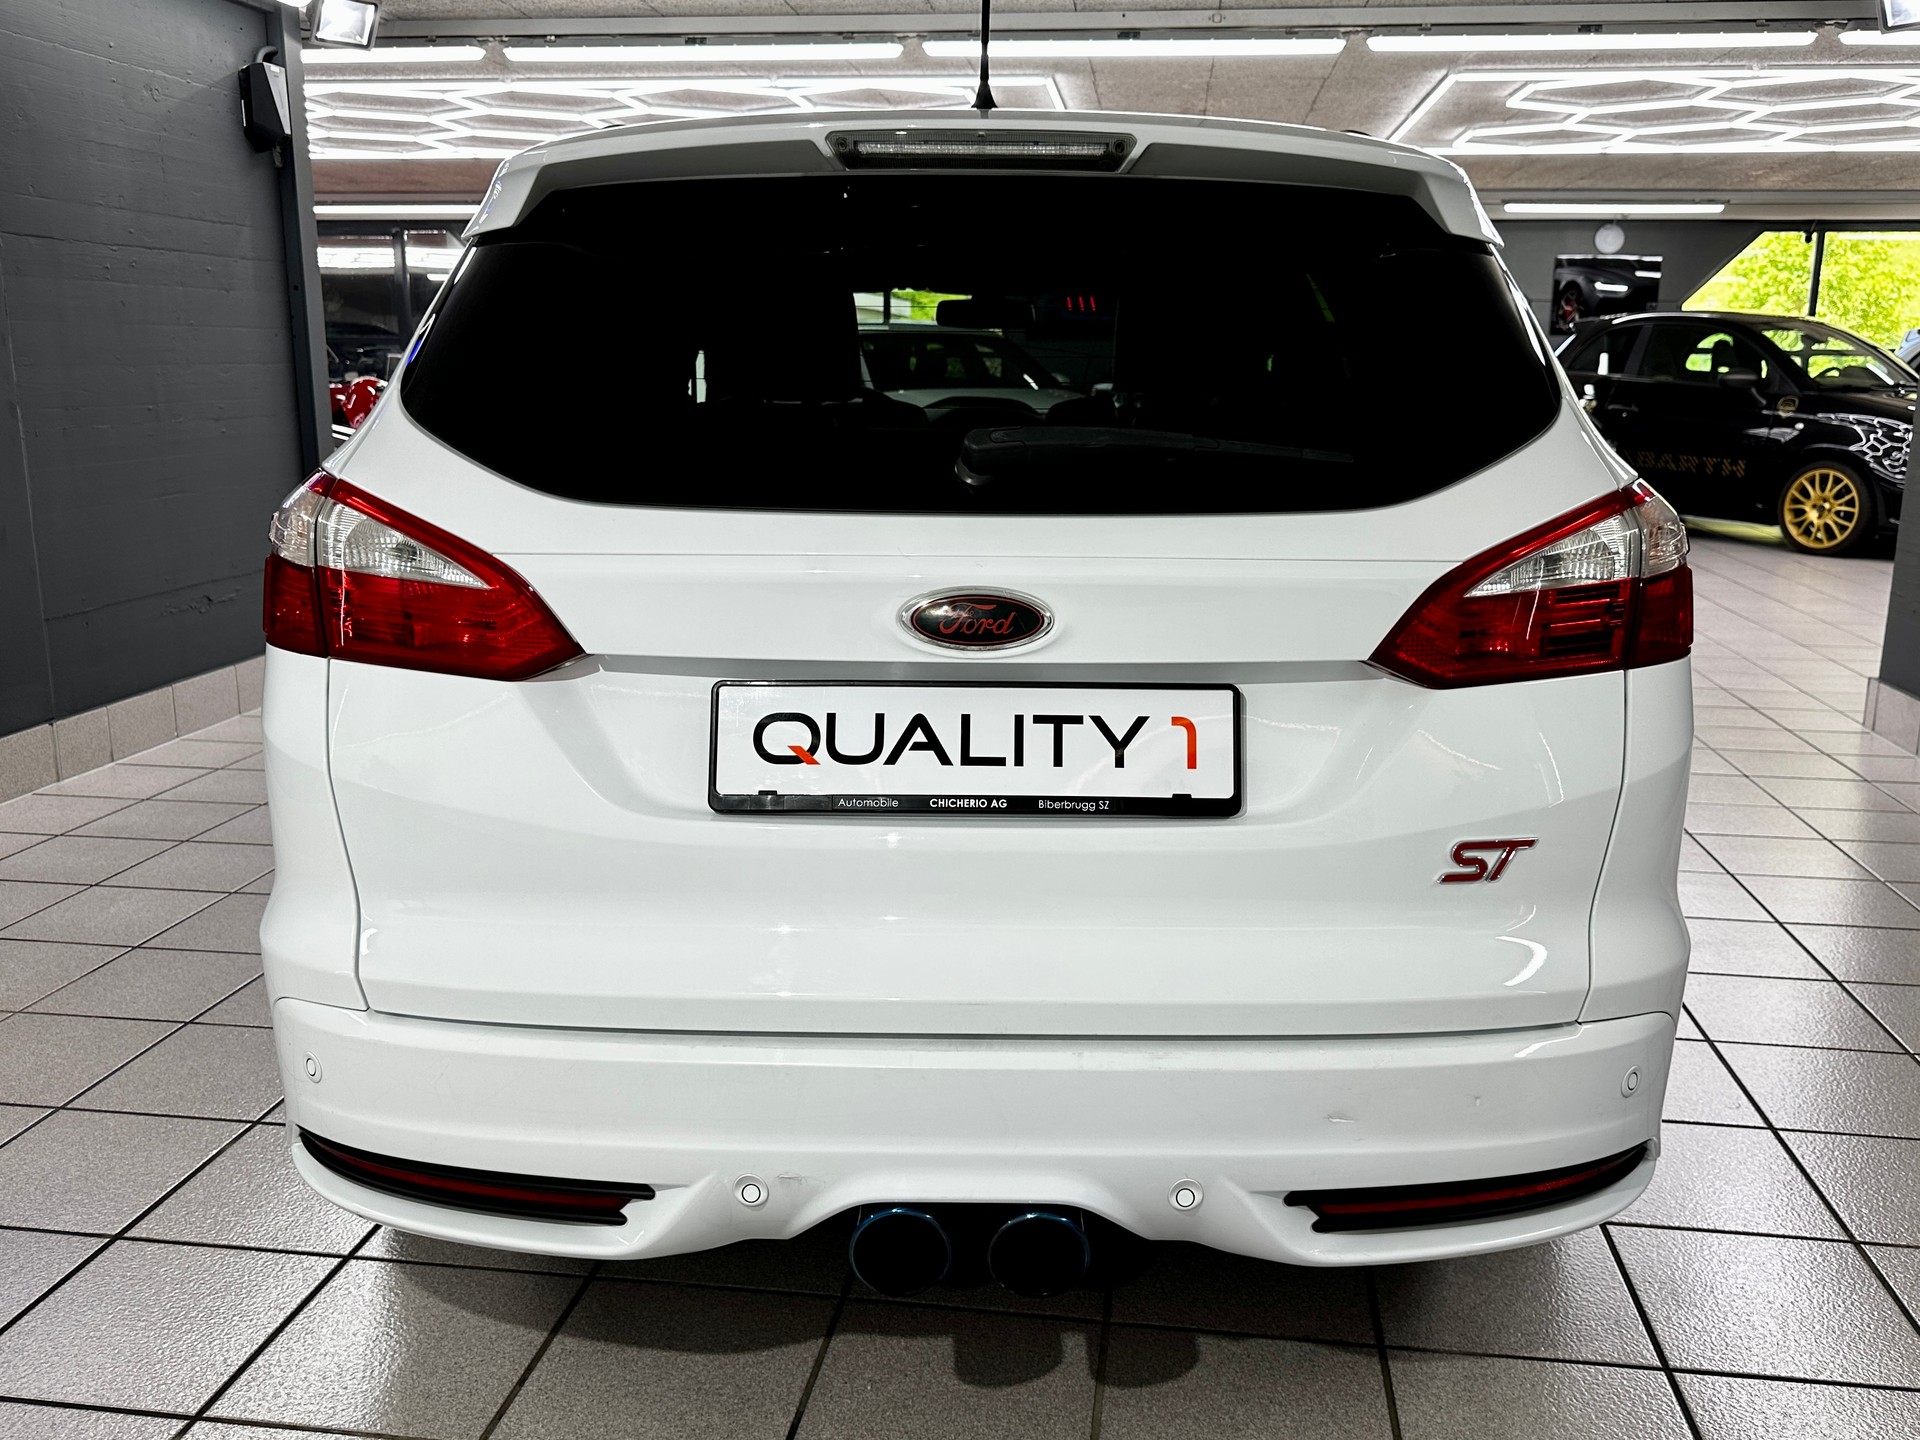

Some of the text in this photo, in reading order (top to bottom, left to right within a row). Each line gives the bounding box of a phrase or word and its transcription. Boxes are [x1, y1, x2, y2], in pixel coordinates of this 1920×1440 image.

[939, 602, 1014, 635] Ford
[753, 712, 1198, 770] QUALITY 1
[838, 798, 1110, 812] Automobile CHICHERIO AG Biberbrugg SZ
[1435, 837, 1539, 884] ST
